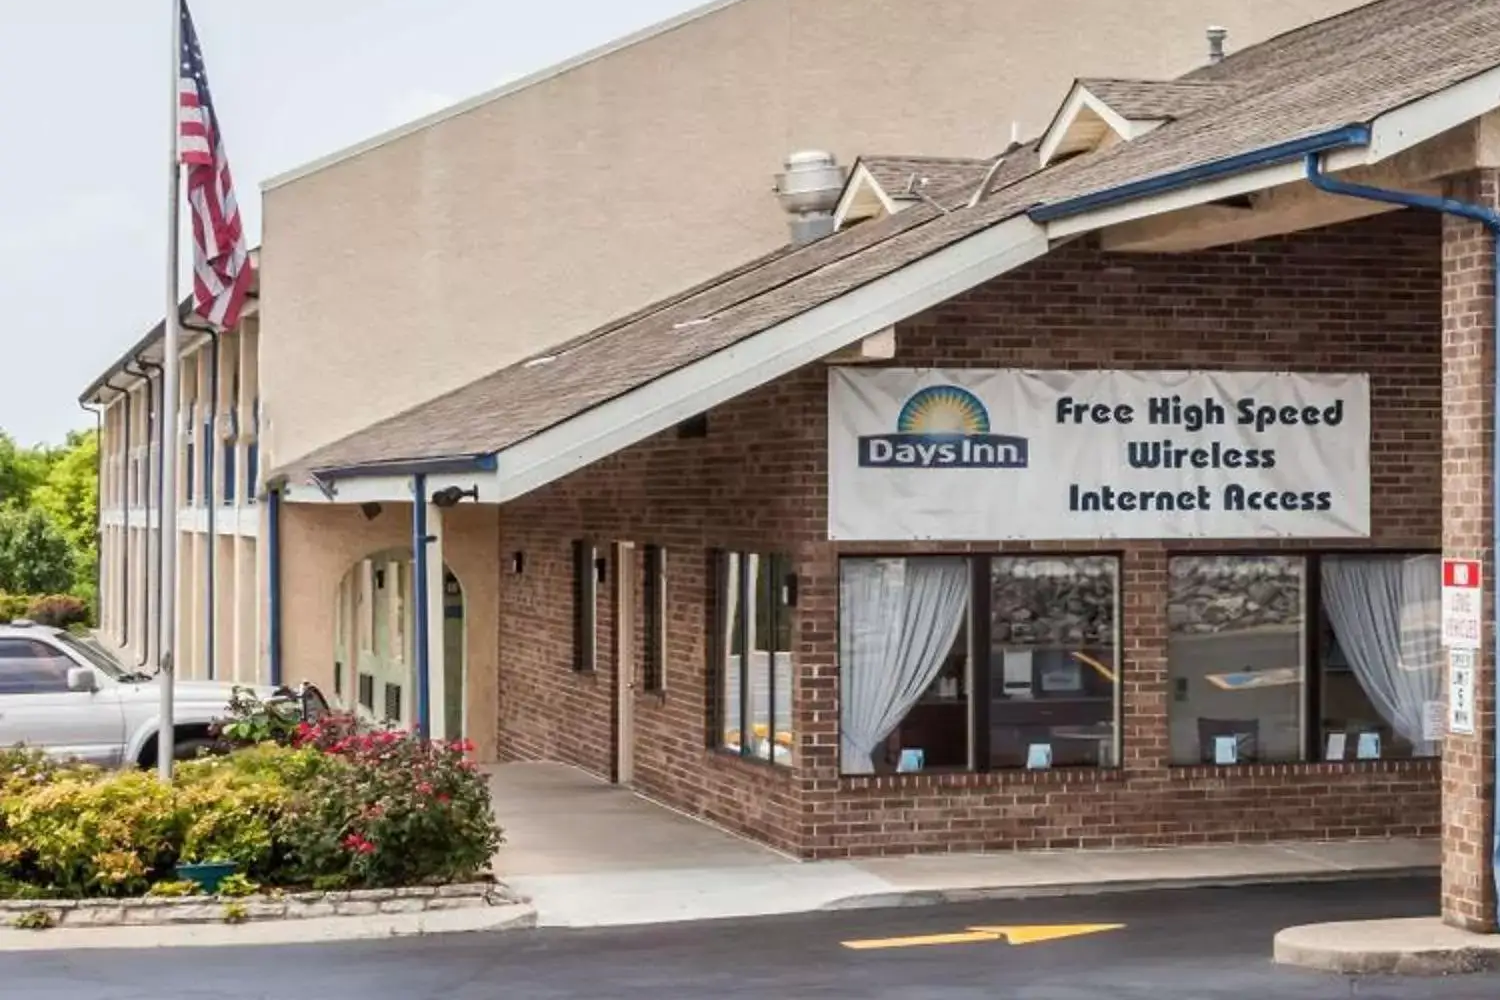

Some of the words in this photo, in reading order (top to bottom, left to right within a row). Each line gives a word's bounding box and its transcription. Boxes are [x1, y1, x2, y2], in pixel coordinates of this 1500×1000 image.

[1055, 396, 1134, 426] Free
[1148, 396, 1225, 432] High
[1237, 397, 1345, 433] Speed
[868, 438, 956, 467] Days
[1127, 441, 1276, 469] Wireless
[1069, 483, 1212, 513] Internet
[1223, 484, 1332, 512] Access
